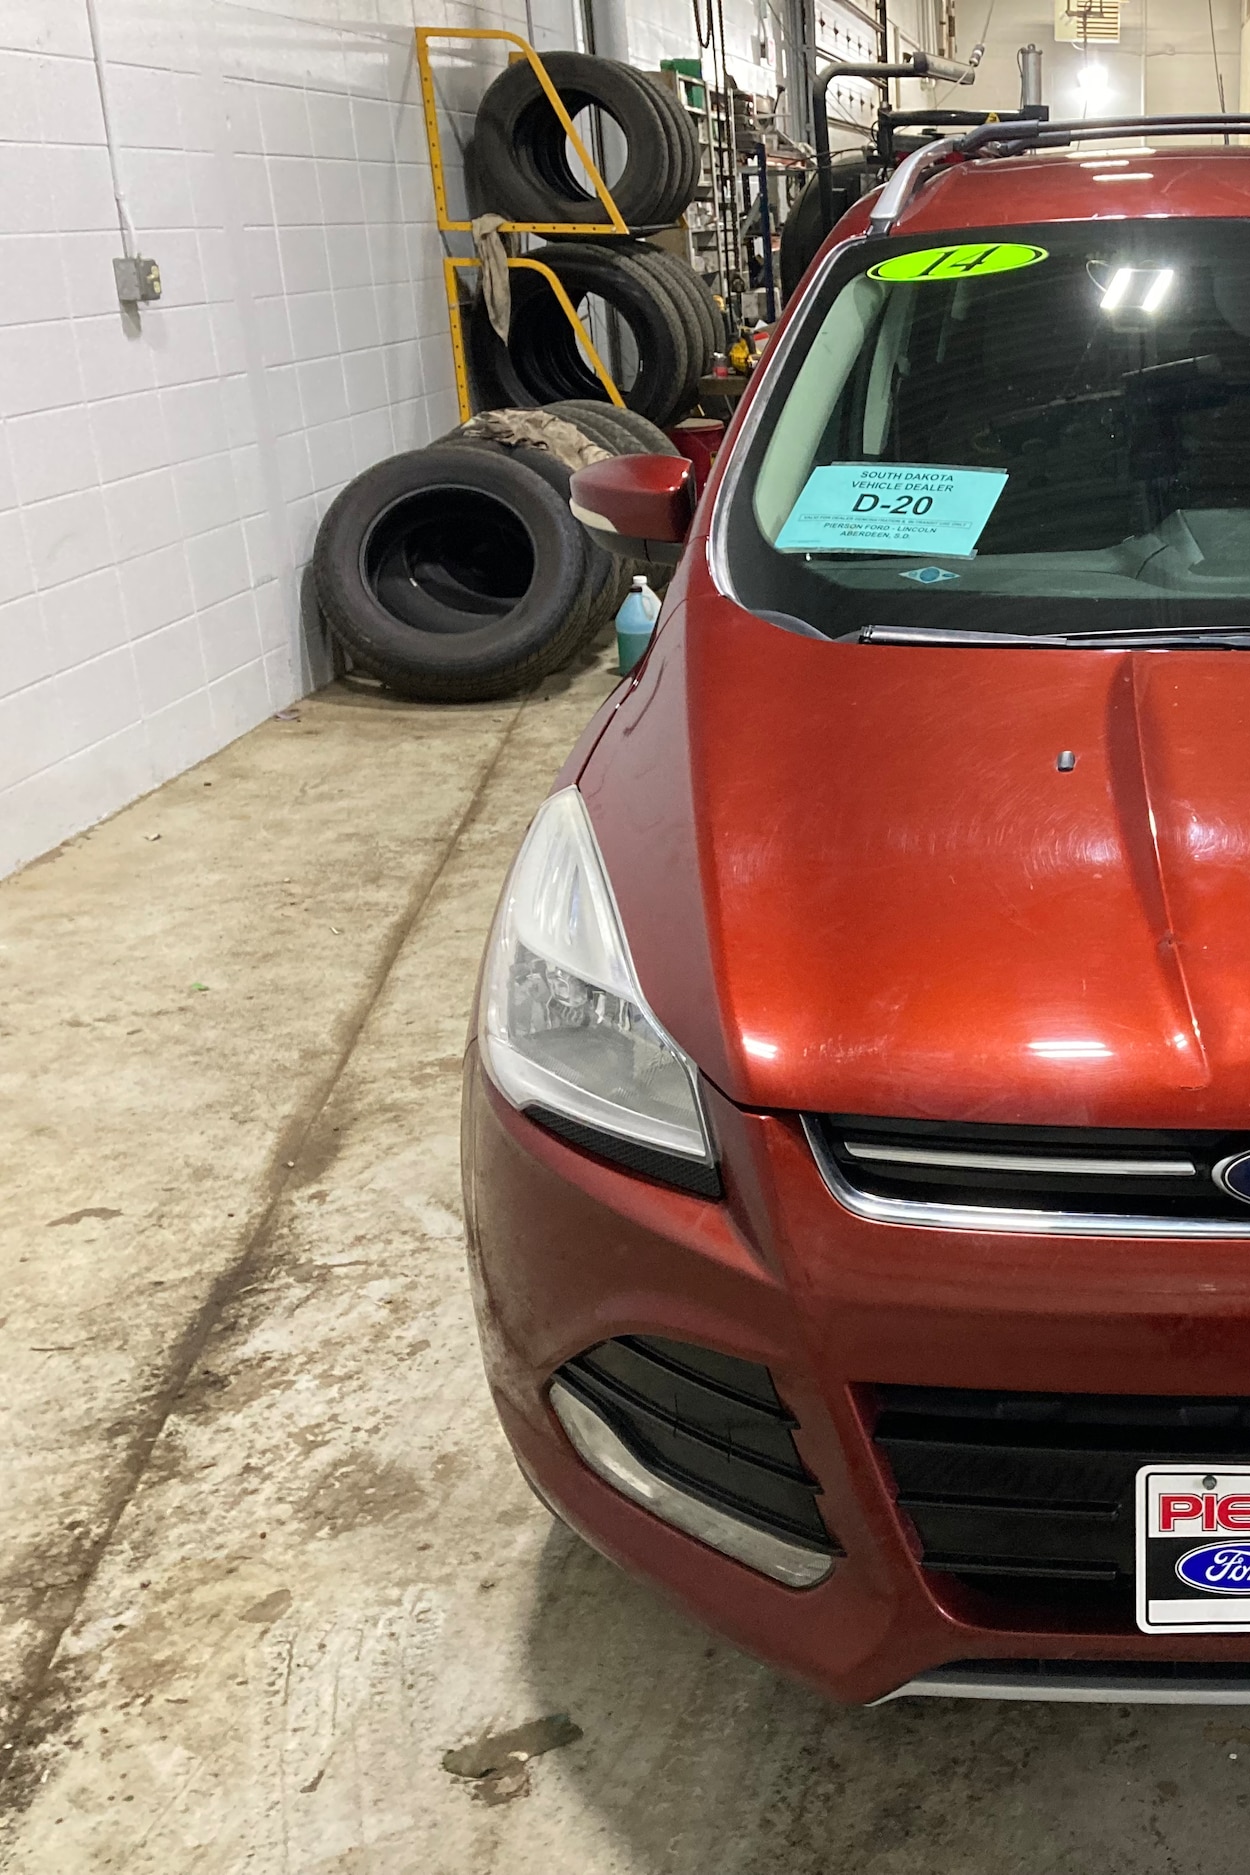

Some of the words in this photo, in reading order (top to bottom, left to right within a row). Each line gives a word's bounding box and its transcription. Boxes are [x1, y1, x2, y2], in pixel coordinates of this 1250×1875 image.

[908, 245, 1002, 277] 14
[860, 470, 902, 480] SOUTH
[904, 472, 954, 482] DAKOTA
[851, 481, 903, 491] VEHICLE
[904, 483, 954, 492] DEALER
[851, 493, 933, 515] D-20
[823, 522, 864, 530] PIERSON
[897, 525, 937, 533] LINCOLN
[839, 530, 891, 539] ABERDEEN,
